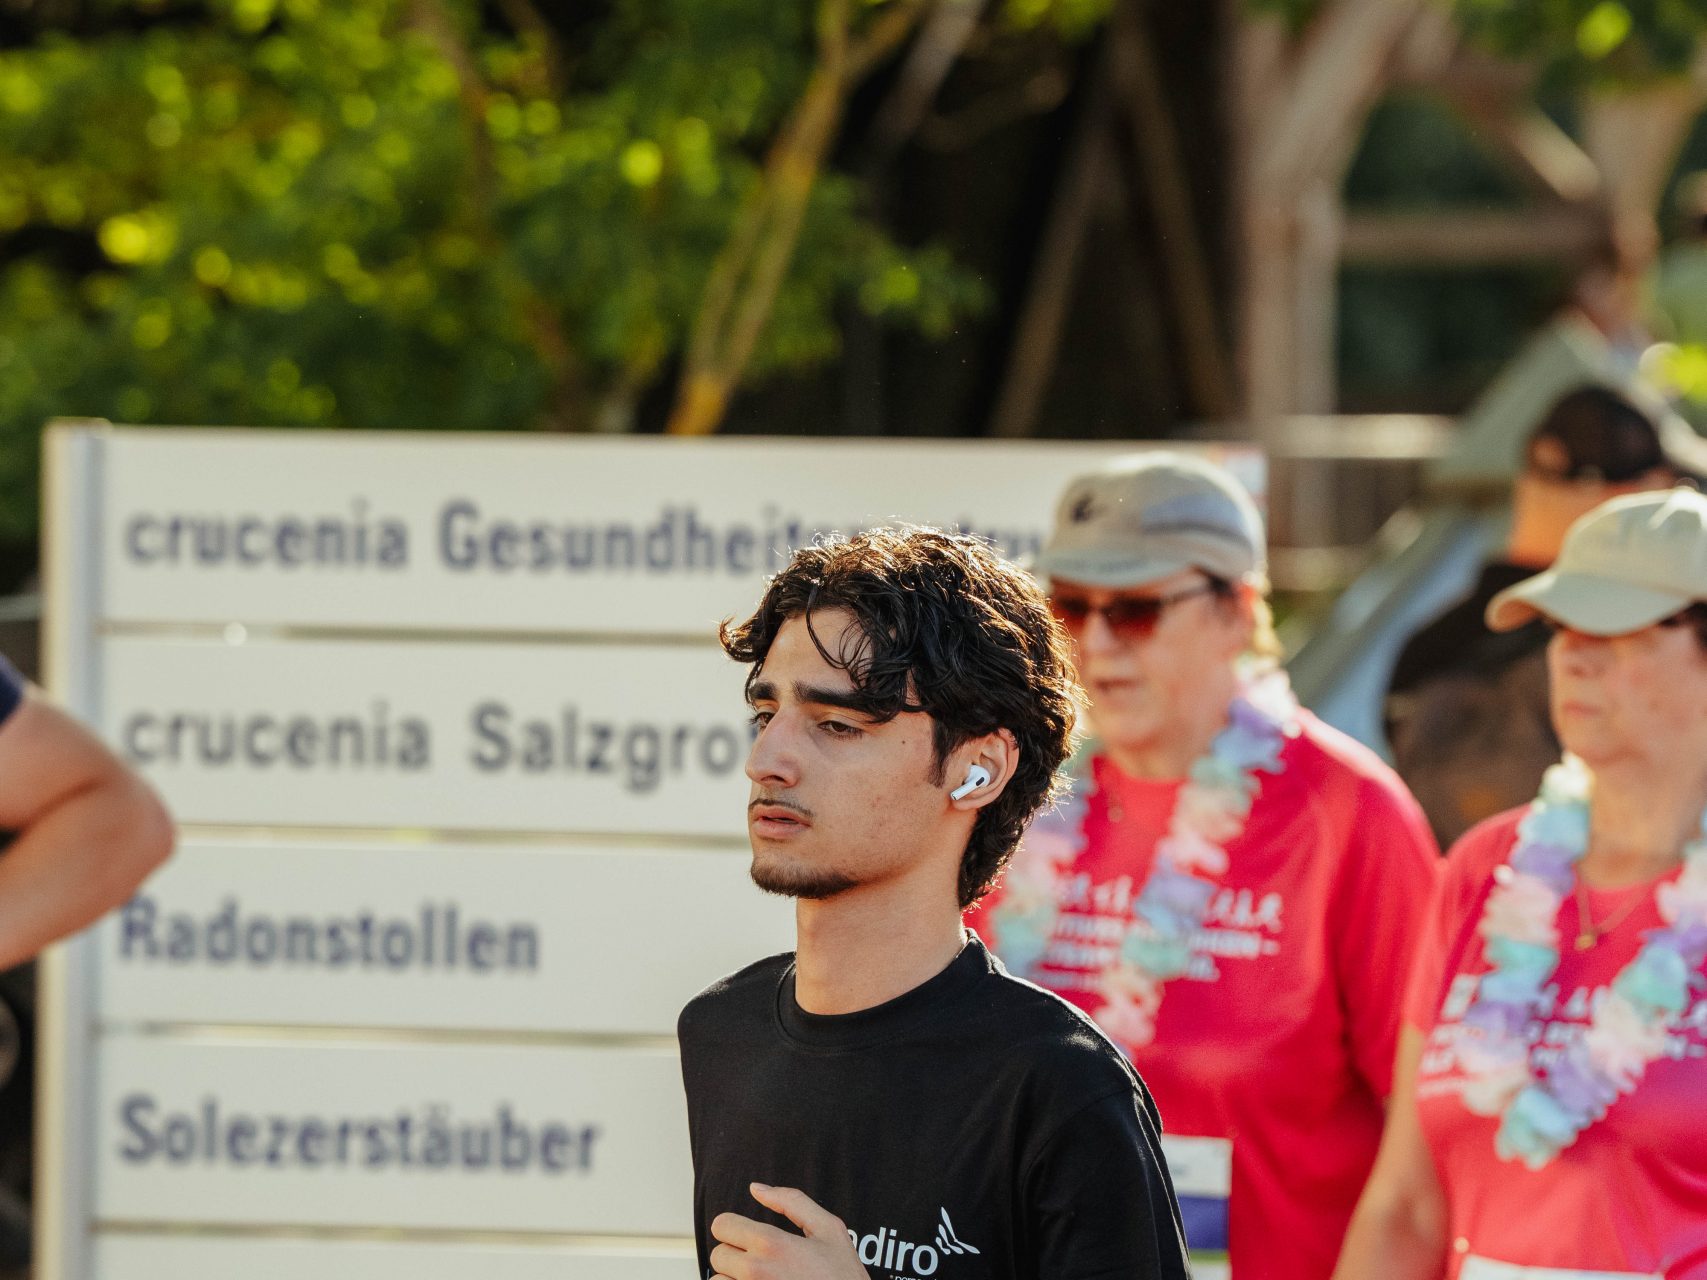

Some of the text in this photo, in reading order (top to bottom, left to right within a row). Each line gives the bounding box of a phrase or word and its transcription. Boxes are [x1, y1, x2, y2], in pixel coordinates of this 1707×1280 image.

[124, 497, 409, 569] crucenia
[124, 698, 757, 795] crucenia Salzgro
[119, 894, 542, 973] Radonstollen
[117, 1095, 601, 1174] Solezerstäuber
